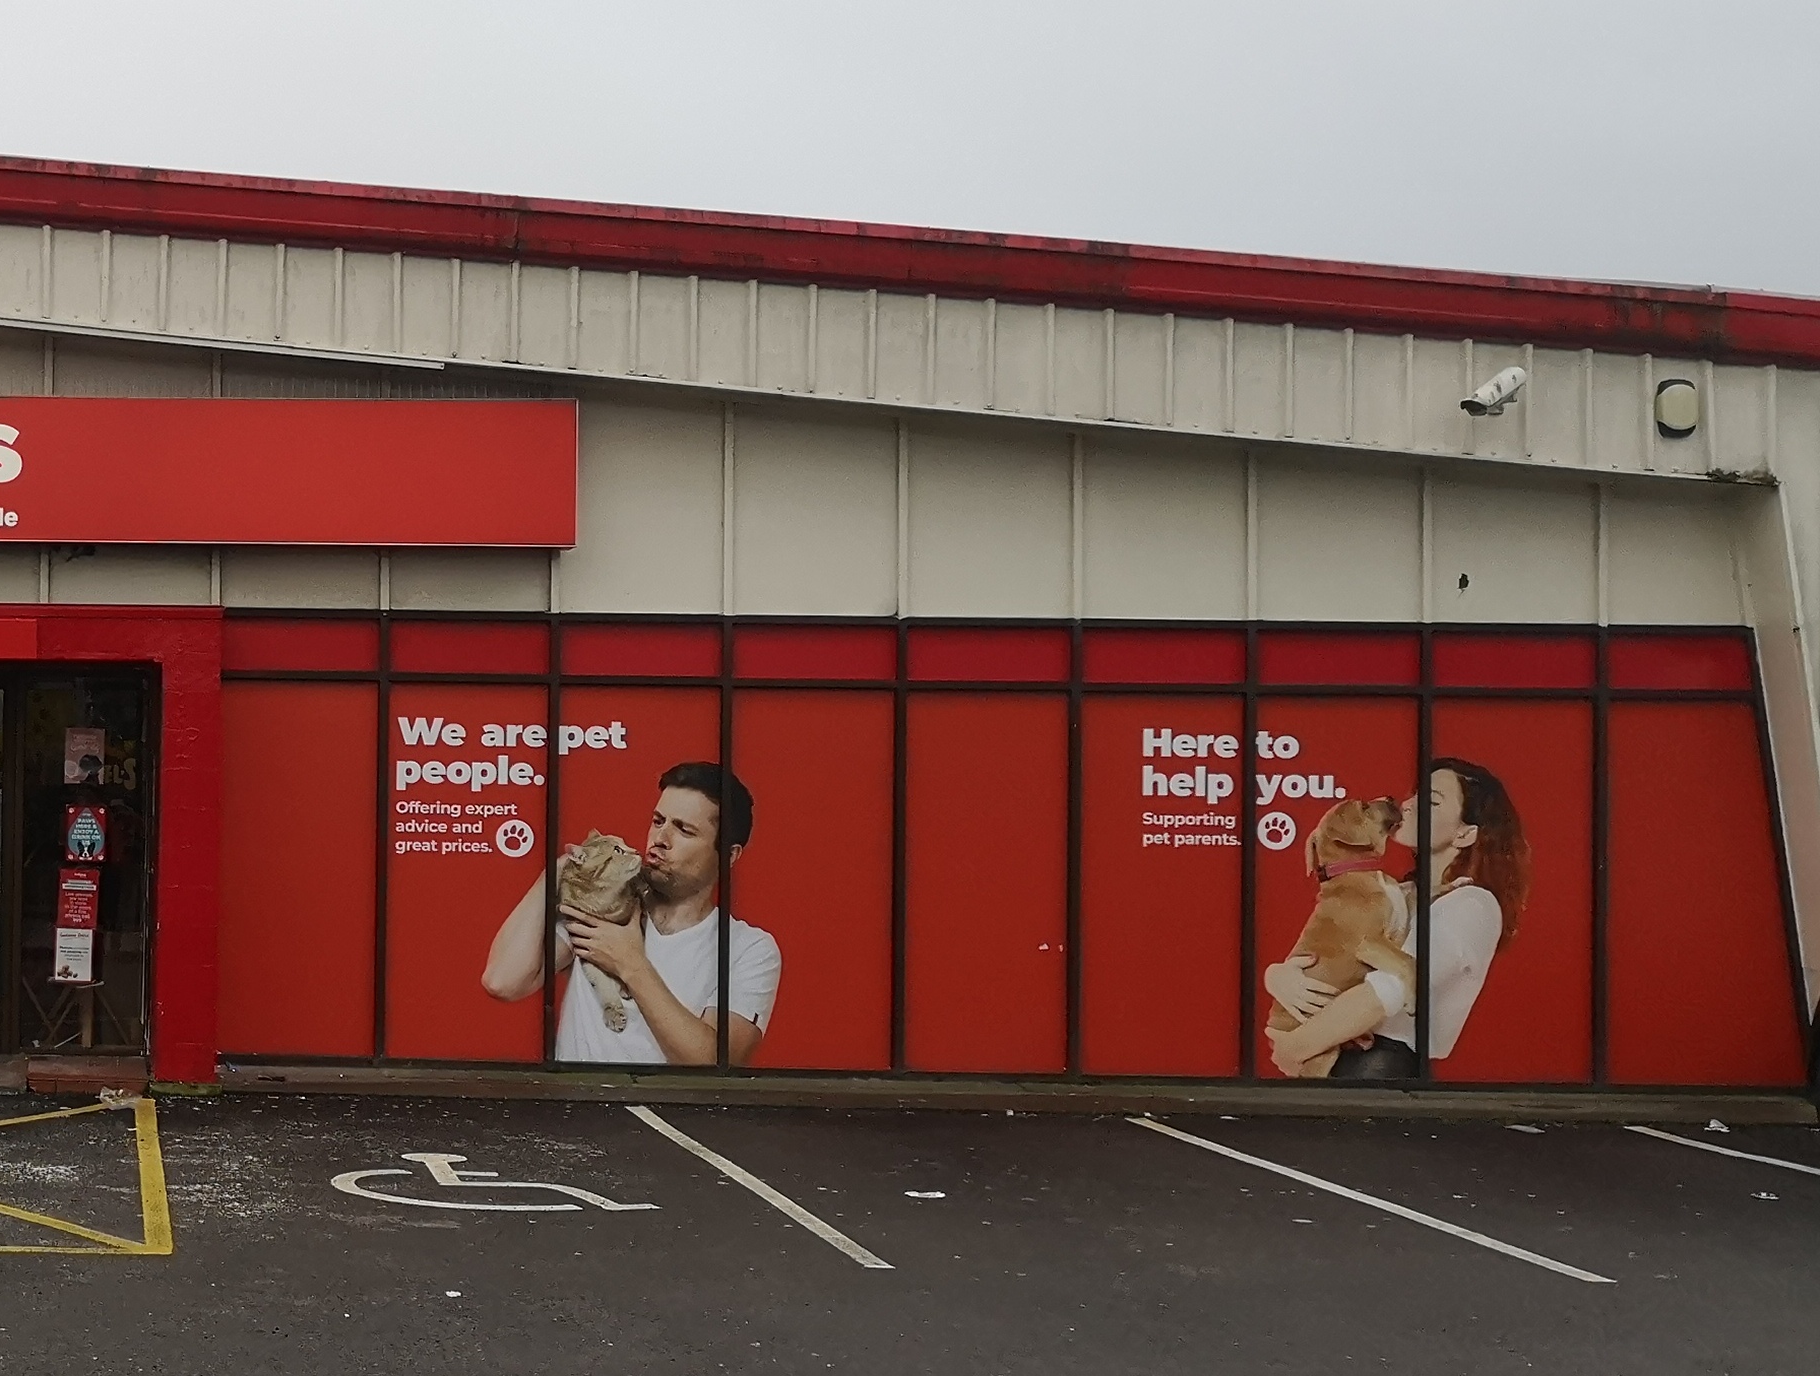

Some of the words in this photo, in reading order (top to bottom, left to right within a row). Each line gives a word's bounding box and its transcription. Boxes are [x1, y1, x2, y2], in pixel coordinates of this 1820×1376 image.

[397, 716, 467, 746] We
[480, 723, 548, 748] are
[558, 721, 627, 756] pet
[1142, 728, 1239, 758] Here
[1255, 730, 1300, 759] to
[395, 755, 545, 792] people.
[1141, 765, 1234, 805] help
[1255, 774, 1347, 805] you.
[395, 800, 462, 818] Offering
[465, 803, 518, 818] expert
[395, 819, 448, 833] advice
[452, 821, 483, 834] and
[1142, 812, 1236, 830] Supporting
[395, 839, 438, 854] great
[442, 839, 493, 856] prices.
[1142, 833, 1171, 848] pet
[1174, 833, 1242, 848] parents.
